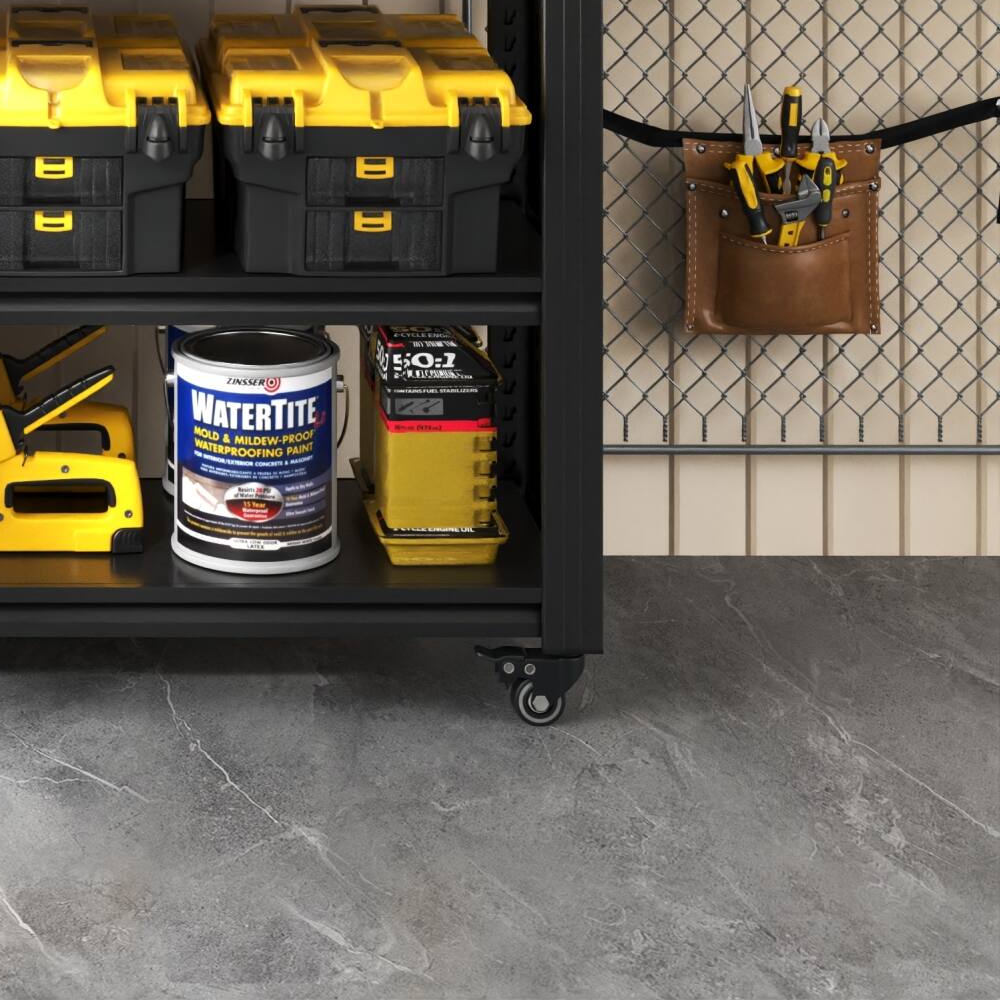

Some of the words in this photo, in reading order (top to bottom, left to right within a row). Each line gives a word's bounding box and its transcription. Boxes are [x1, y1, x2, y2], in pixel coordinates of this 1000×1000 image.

[226, 378, 265, 387] ZINSSER
[191, 388, 317, 431] WATERTITE
[193, 425, 219, 441] MOLD
[222, 433, 230, 444] &
[234, 429, 314, 446] MILDEW-PROOF
[194, 437, 283, 458] WATERPROOFING
[286, 441, 314, 456] PAINT
